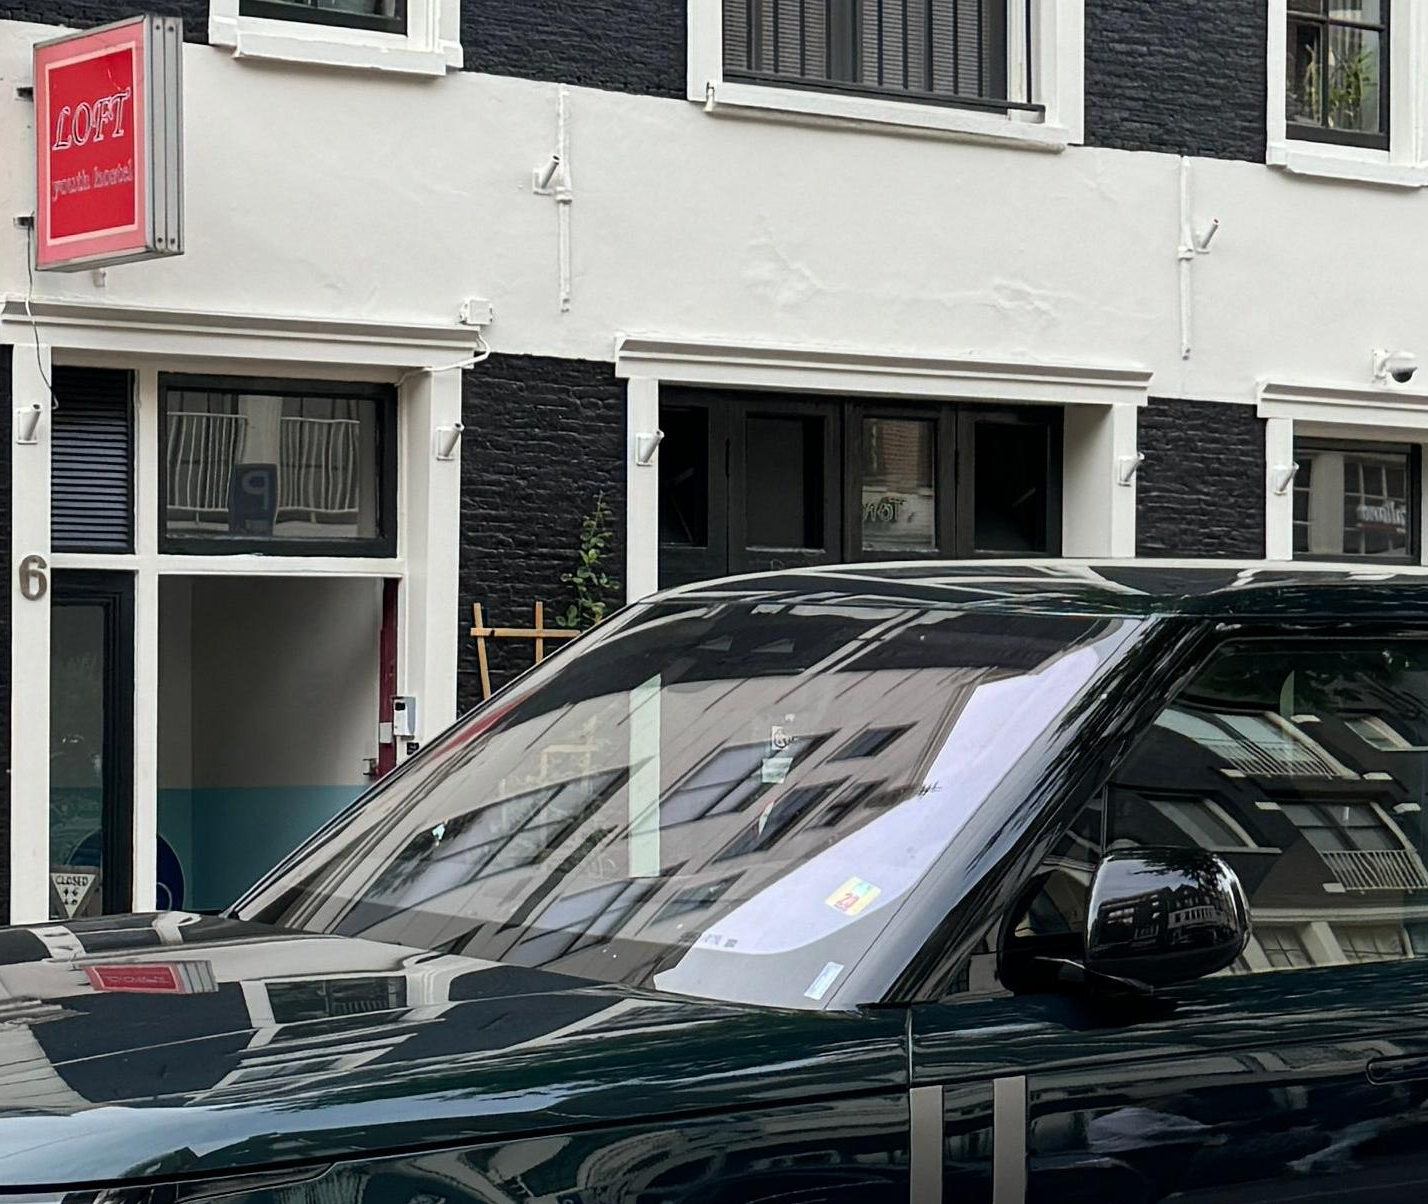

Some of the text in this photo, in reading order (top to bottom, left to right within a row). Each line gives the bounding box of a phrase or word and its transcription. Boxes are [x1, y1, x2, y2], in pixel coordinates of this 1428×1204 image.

[52, 86, 131, 151] LOFT
[52, 157, 134, 203] youth hostel
[18, 554, 48, 601] 6
[55, 875, 89, 887] CLOSED
